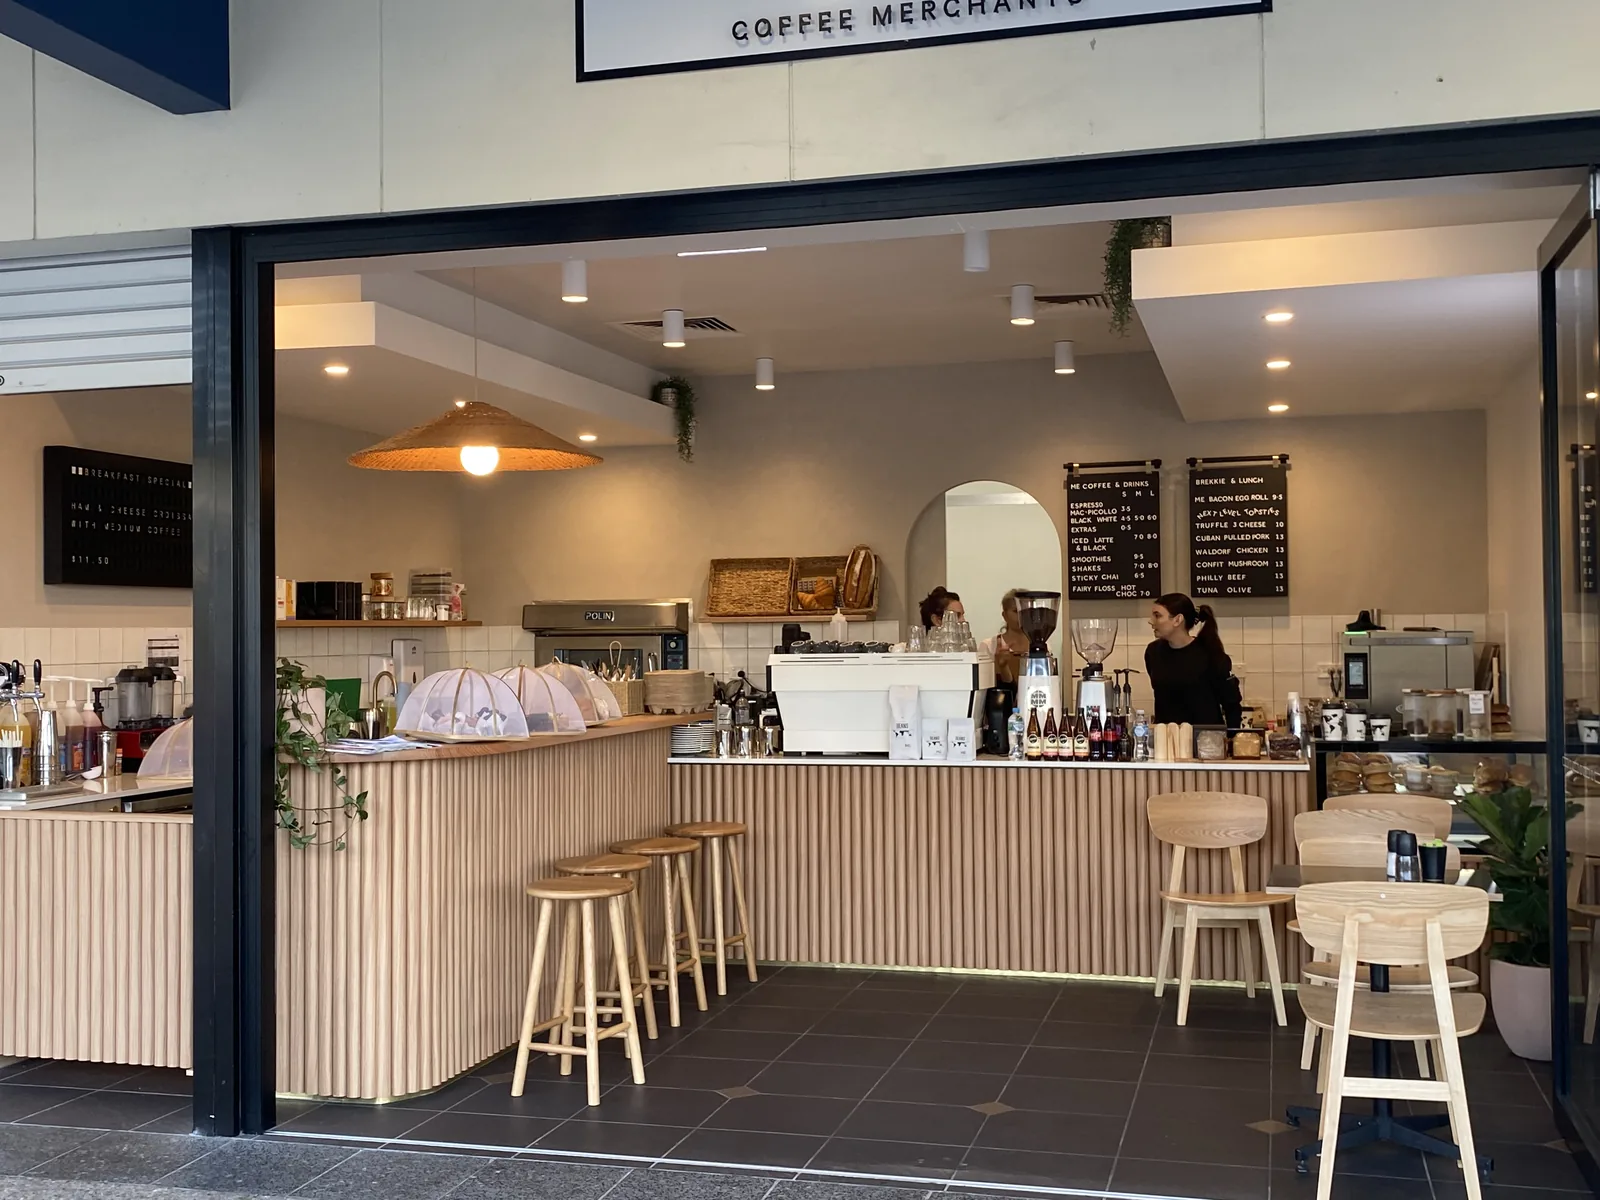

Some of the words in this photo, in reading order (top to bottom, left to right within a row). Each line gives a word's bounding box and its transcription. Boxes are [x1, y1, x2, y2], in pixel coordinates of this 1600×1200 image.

[732, 9, 852, 41] COFFEE
[872, 0, 1083, 26] MERCHA
[85, 468, 140, 482] BREAKFAST
[148, 476, 187, 488] SPECIAL
[111, 506, 146, 517] CHEESE
[1197, 510, 1217, 519] NEXT
[1220, 508, 1241, 517] LEVEL
[1244, 507, 1279, 516] TOASTIES
[148, 526, 181, 536] COFFEE
[586, 611, 611, 620] POLIN
